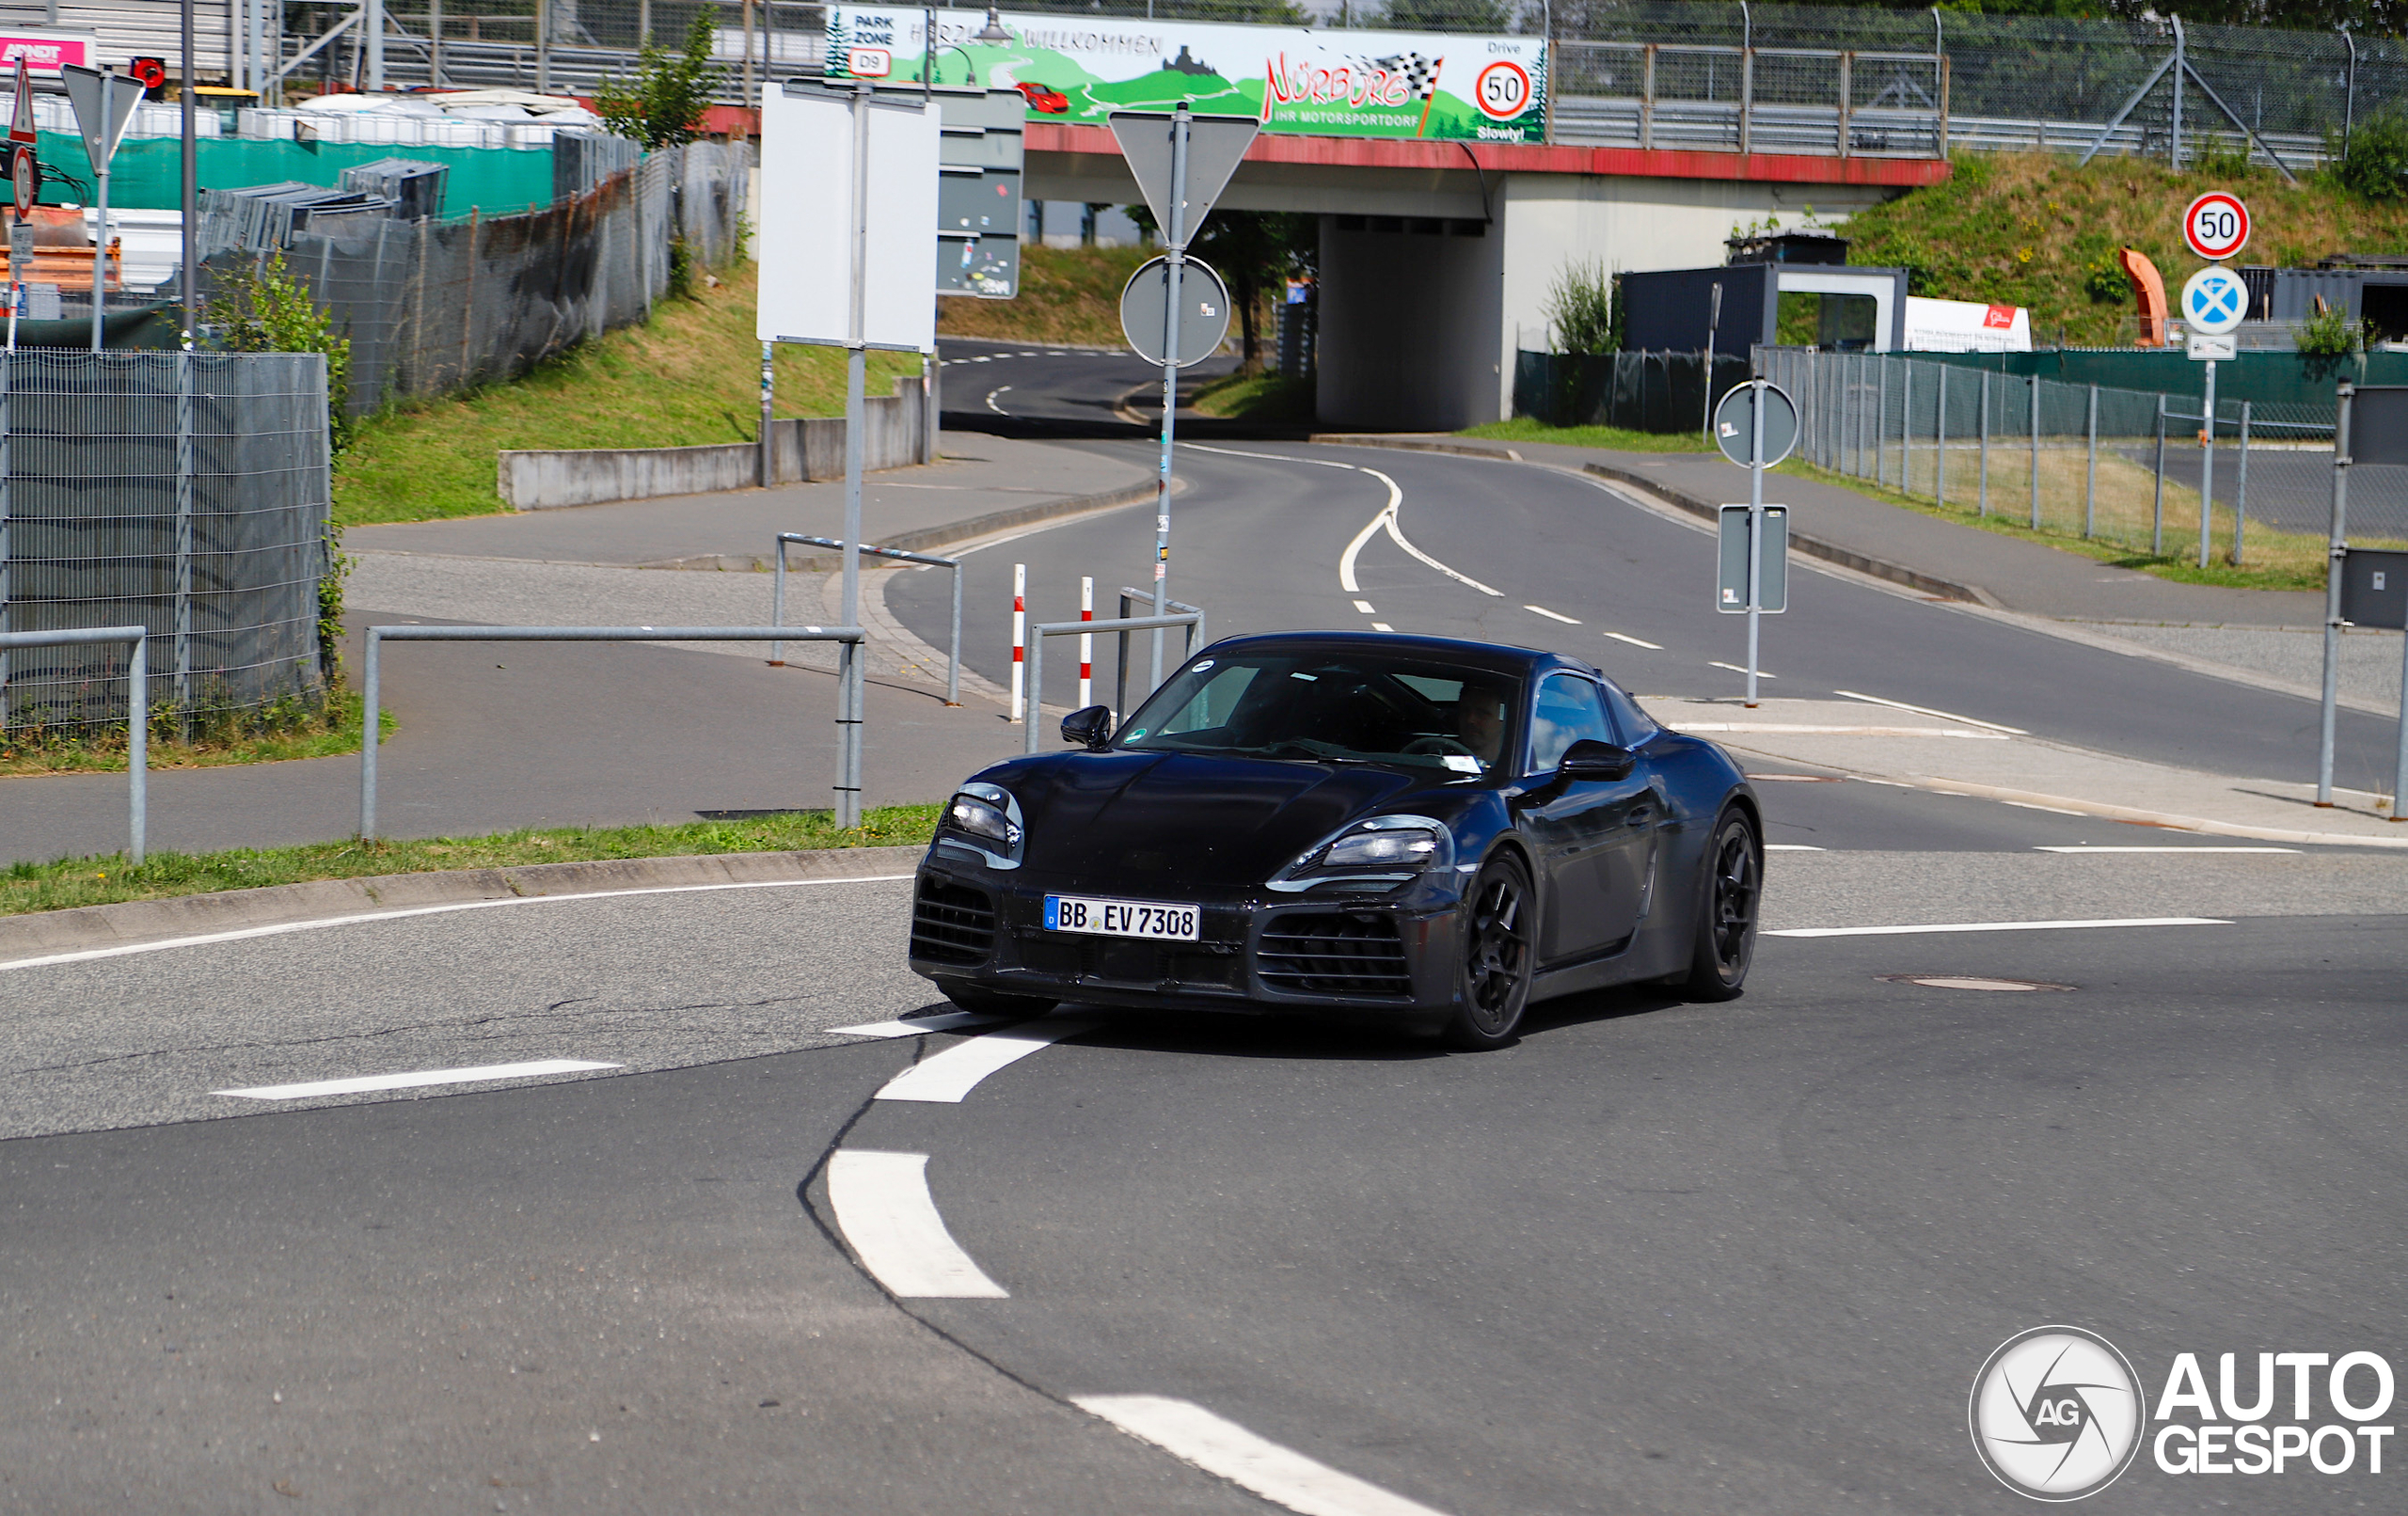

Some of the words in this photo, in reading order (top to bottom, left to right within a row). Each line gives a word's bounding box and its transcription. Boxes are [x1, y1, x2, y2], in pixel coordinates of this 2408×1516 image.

[855, 16, 893, 27] PARK
[854, 32, 894, 45] ZONE
[1023, 29, 1163, 56] WILLKOMMEN
[1488, 41, 1521, 55] Drive
[859, 55, 879, 69] D9
[1261, 51, 1410, 124] NÜRBURG
[1488, 77, 1519, 102] 50
[1275, 110, 1296, 122] IHR
[1300, 112, 1419, 127] MOTORSPORTDORF
[1477, 125, 1525, 142] Slowly!
[2201, 213, 2234, 238] 50
[1059, 902, 1086, 927] BB
[1104, 906, 1133, 931] EV
[1139, 908, 1194, 936] 7308
